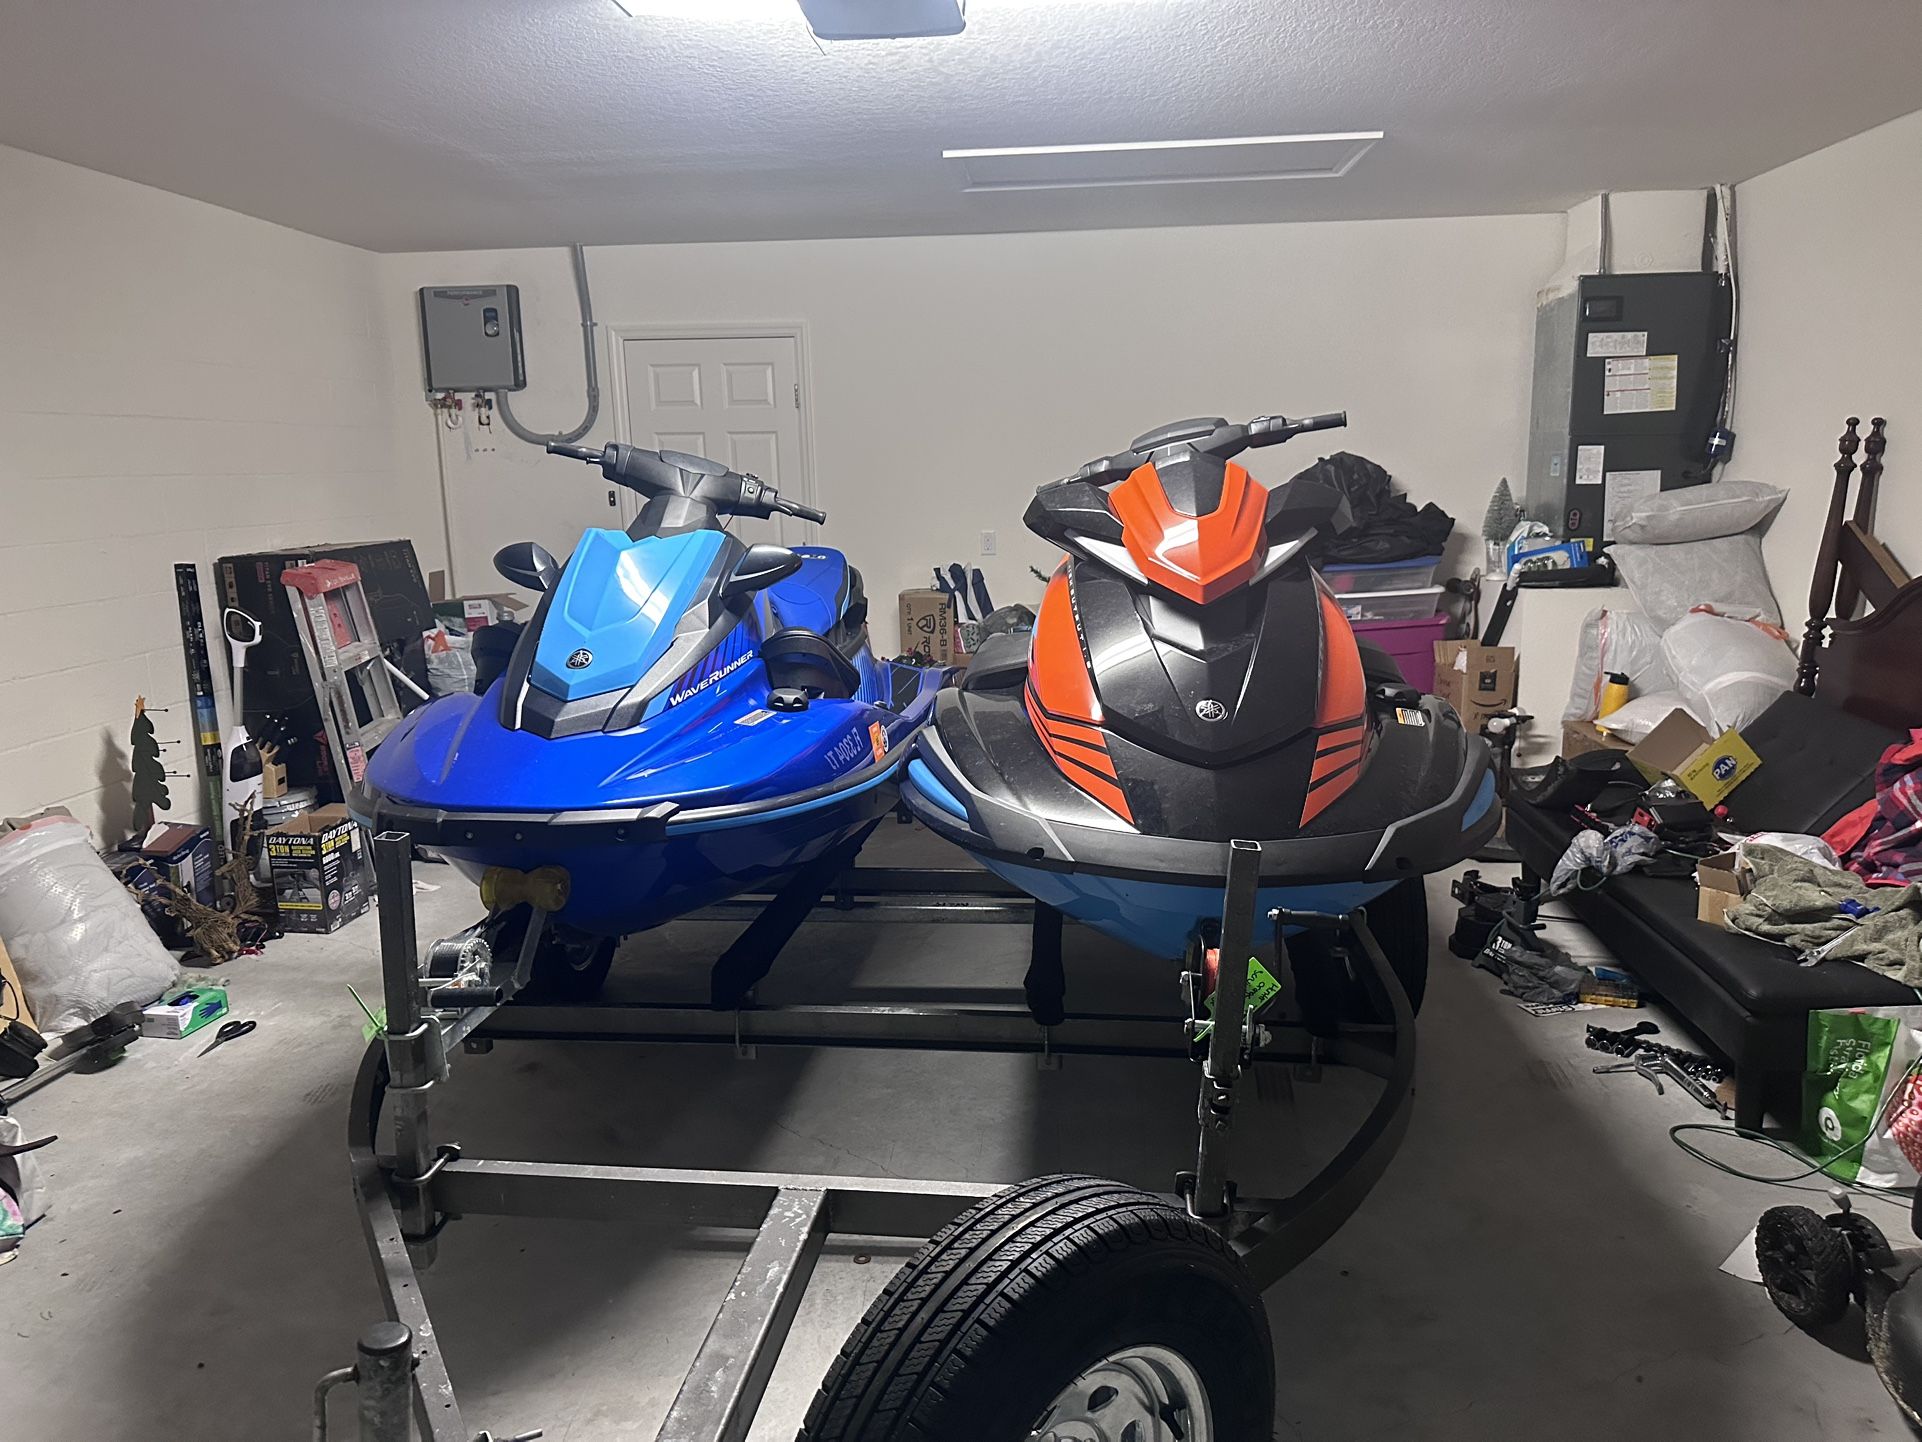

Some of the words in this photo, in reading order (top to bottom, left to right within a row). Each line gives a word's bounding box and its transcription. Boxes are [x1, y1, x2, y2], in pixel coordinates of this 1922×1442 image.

[939, 602, 947, 647] RM36-B
[321, 820, 358, 843] DAYTONA
[268, 836, 314, 845] DAYTONA
[269, 844, 277, 856] 3
[276, 844, 290, 853] TON
[321, 843, 327, 855] 3
